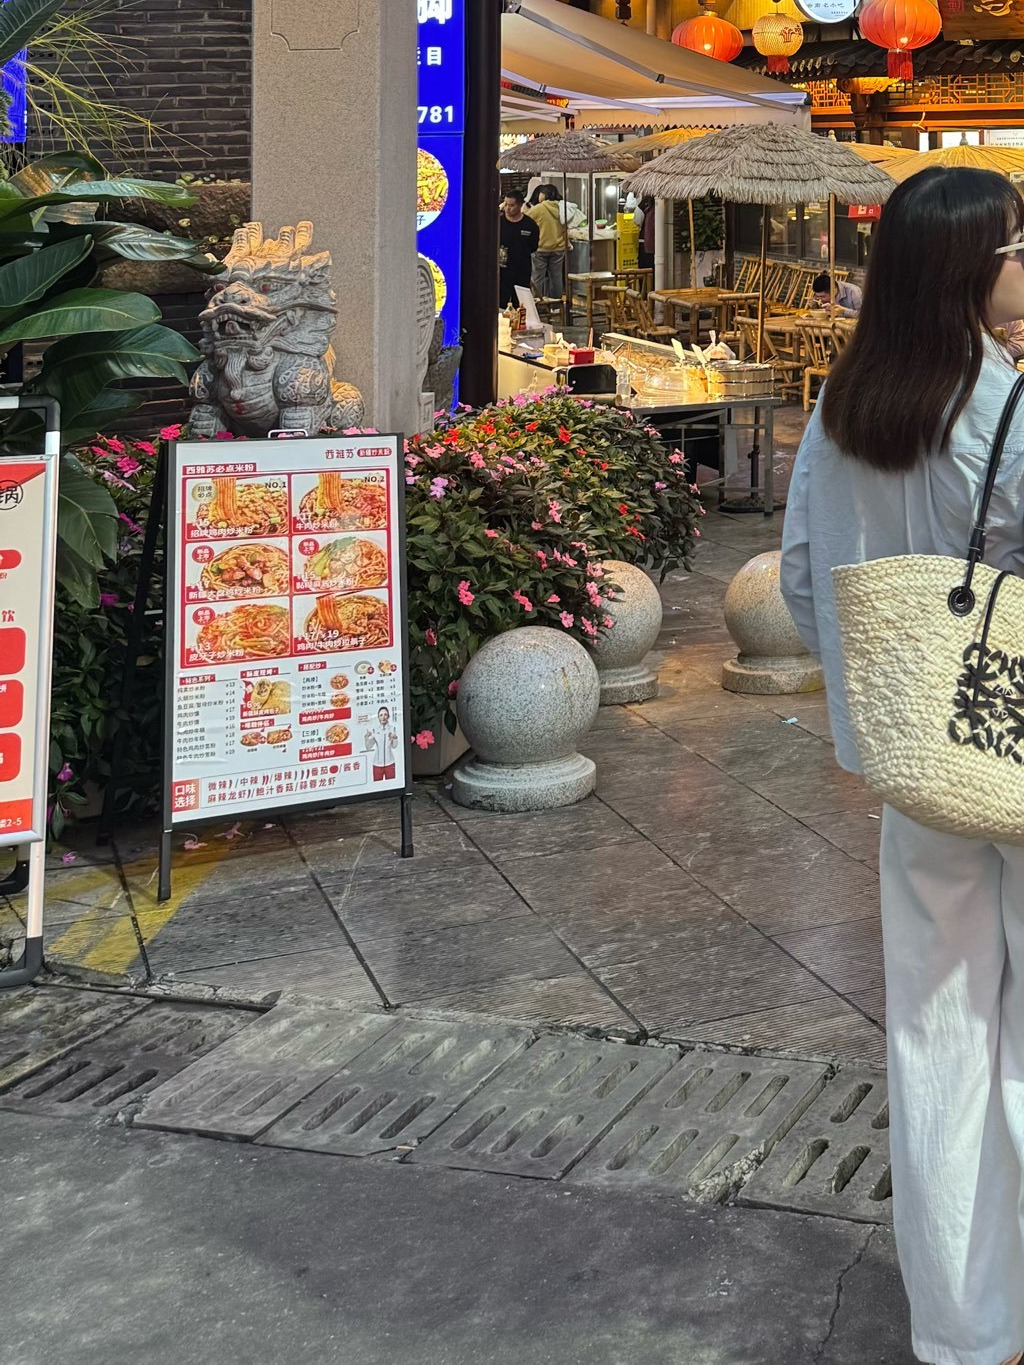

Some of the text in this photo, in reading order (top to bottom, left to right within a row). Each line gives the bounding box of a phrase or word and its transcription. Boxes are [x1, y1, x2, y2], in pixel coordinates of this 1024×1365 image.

[417, 46, 442, 66] 目
[186, 463, 254, 475] 西雅苏必点米粉
[364, 475, 385, 483] NO.2
[264, 481, 287, 489] NO.1
[0, 484, 18, 504] 锅
[190, 527, 254, 538] 招牌鸡肉炒米粉
[175, 784, 197, 795] 口味
[174, 796, 196, 808] 选择
